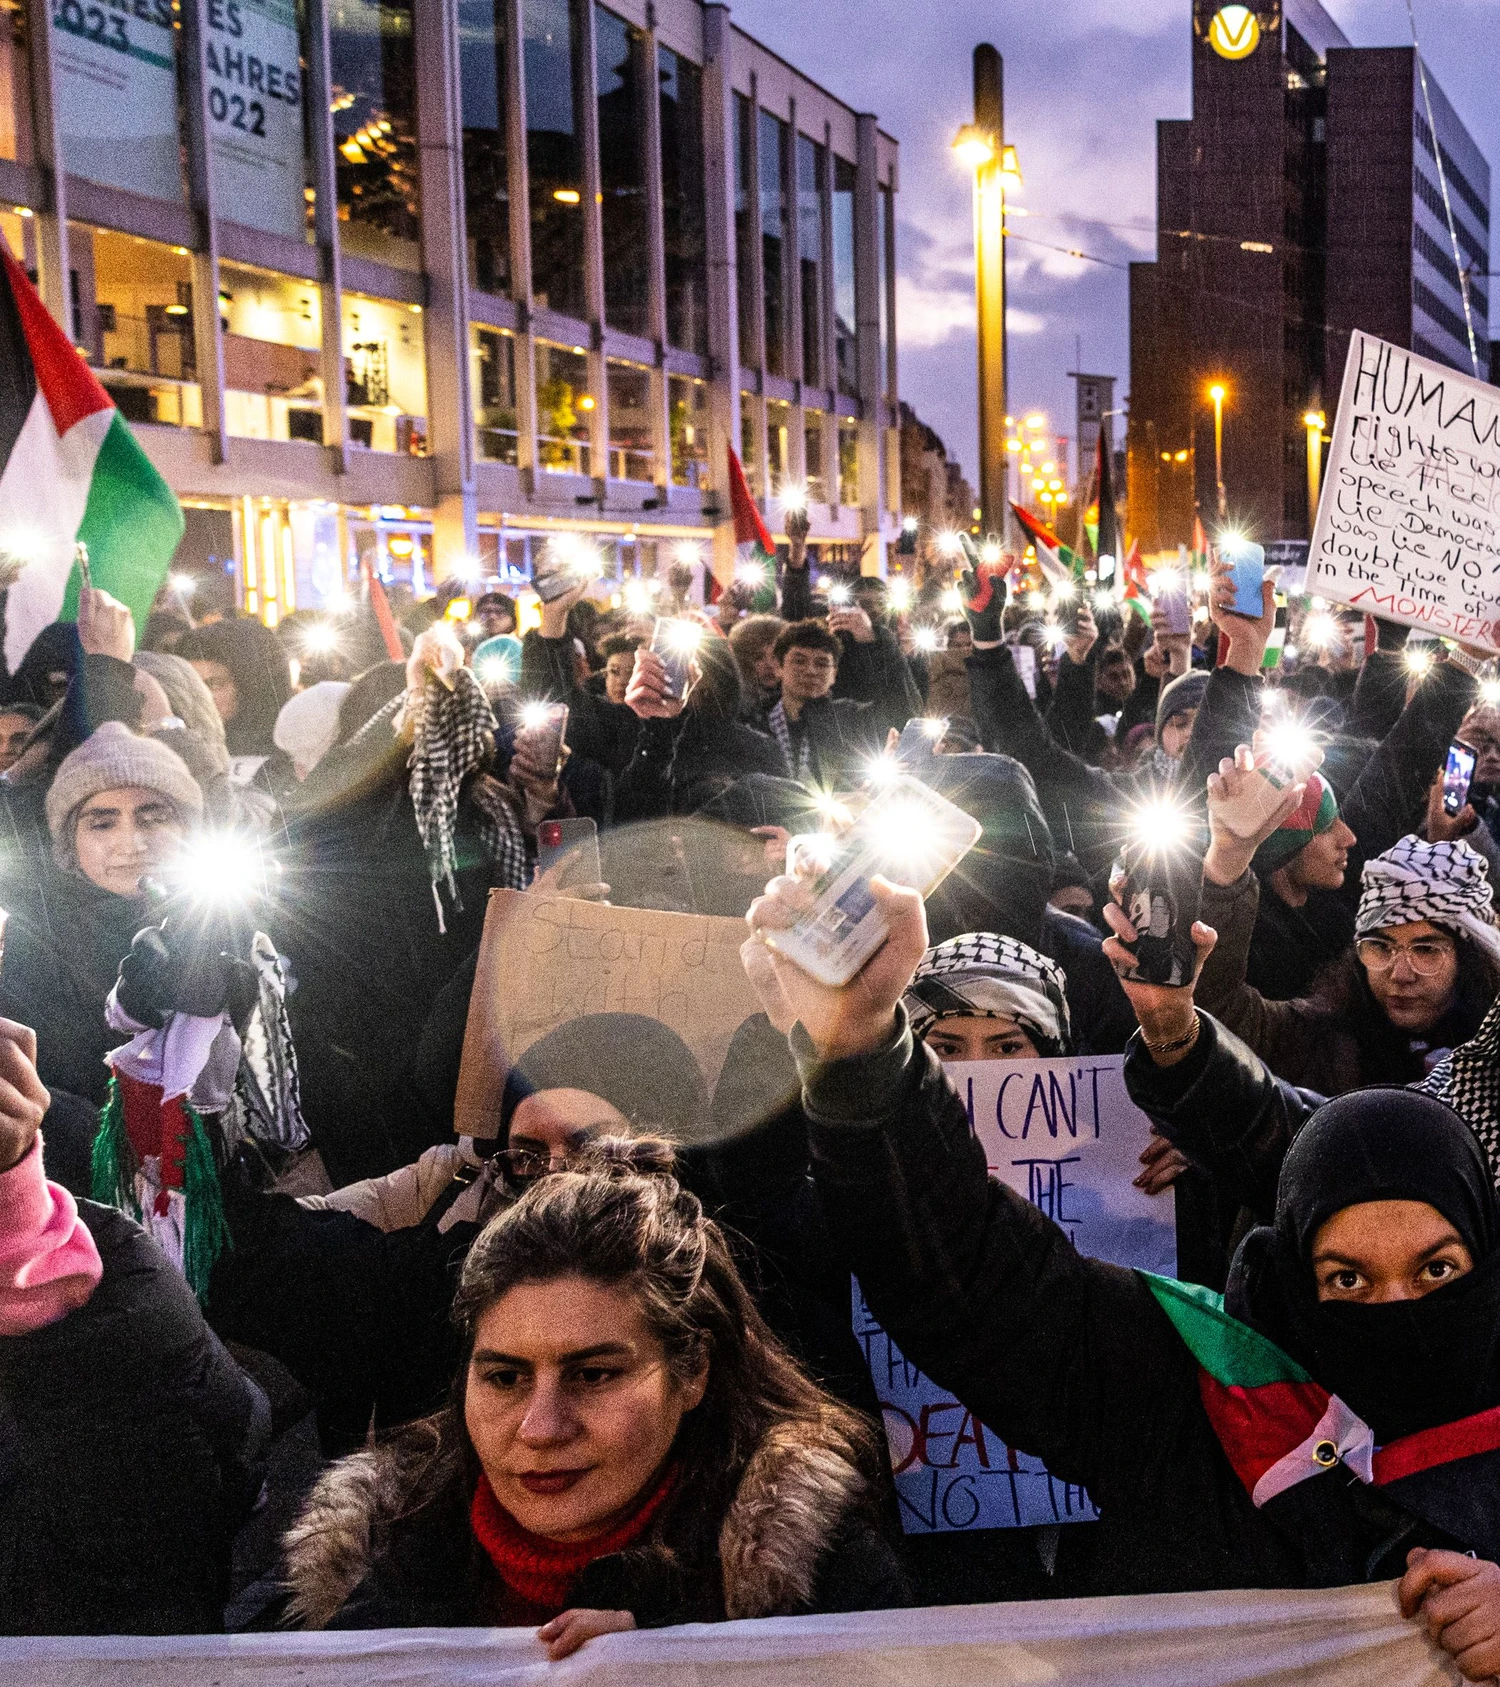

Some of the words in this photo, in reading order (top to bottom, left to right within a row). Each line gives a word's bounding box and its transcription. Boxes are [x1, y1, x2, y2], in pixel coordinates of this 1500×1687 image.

[1352, 416, 1459, 466] rights
[1331, 515, 1378, 541] was
[1441, 548, 1482, 578] NO
[1452, 510, 1496, 536] was
[1317, 558, 1336, 577] in
[1348, 562, 1385, 587] the
[1464, 601, 1487, 618] of
[1415, 568, 1448, 587] we
[525, 901, 716, 974] Stand
[997, 1067, 1116, 1139] CAN'T
[1011, 1157, 1083, 1223] THE
